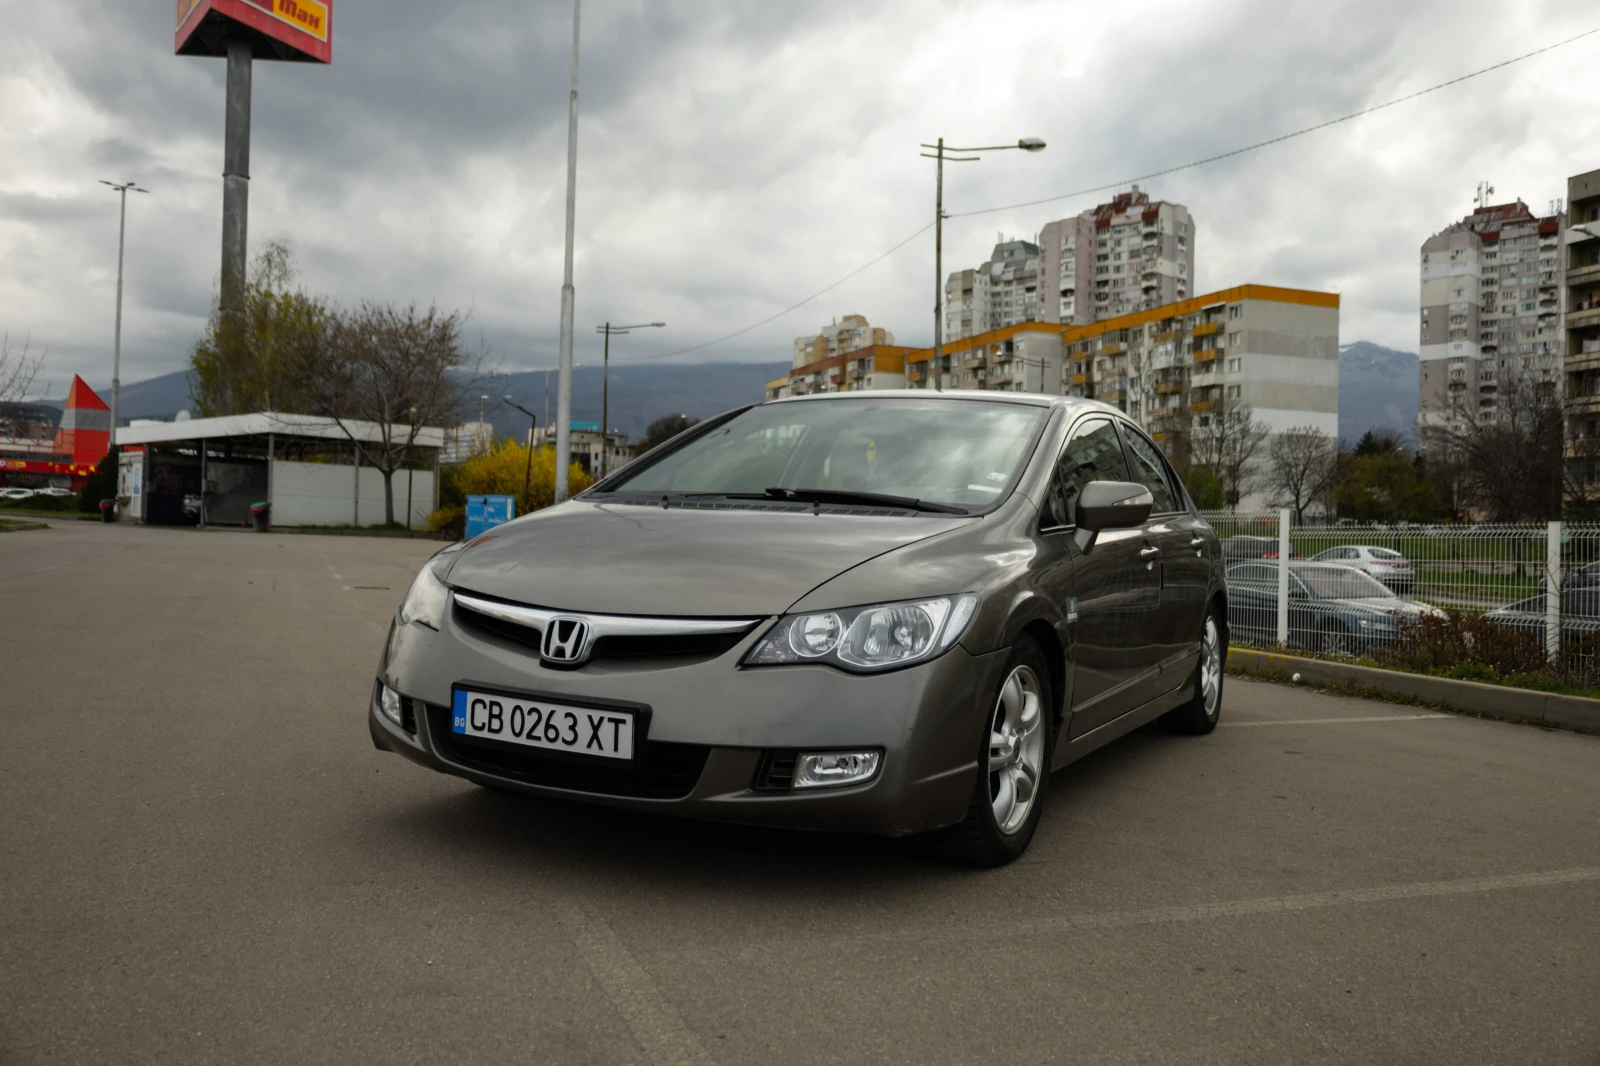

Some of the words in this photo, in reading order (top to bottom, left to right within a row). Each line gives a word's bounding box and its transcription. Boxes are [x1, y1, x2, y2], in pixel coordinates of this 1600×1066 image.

[454, 716, 465, 728] BG
[470, 698, 504, 734] CB
[510, 704, 579, 746] 0263
[586, 714, 627, 753] XT
